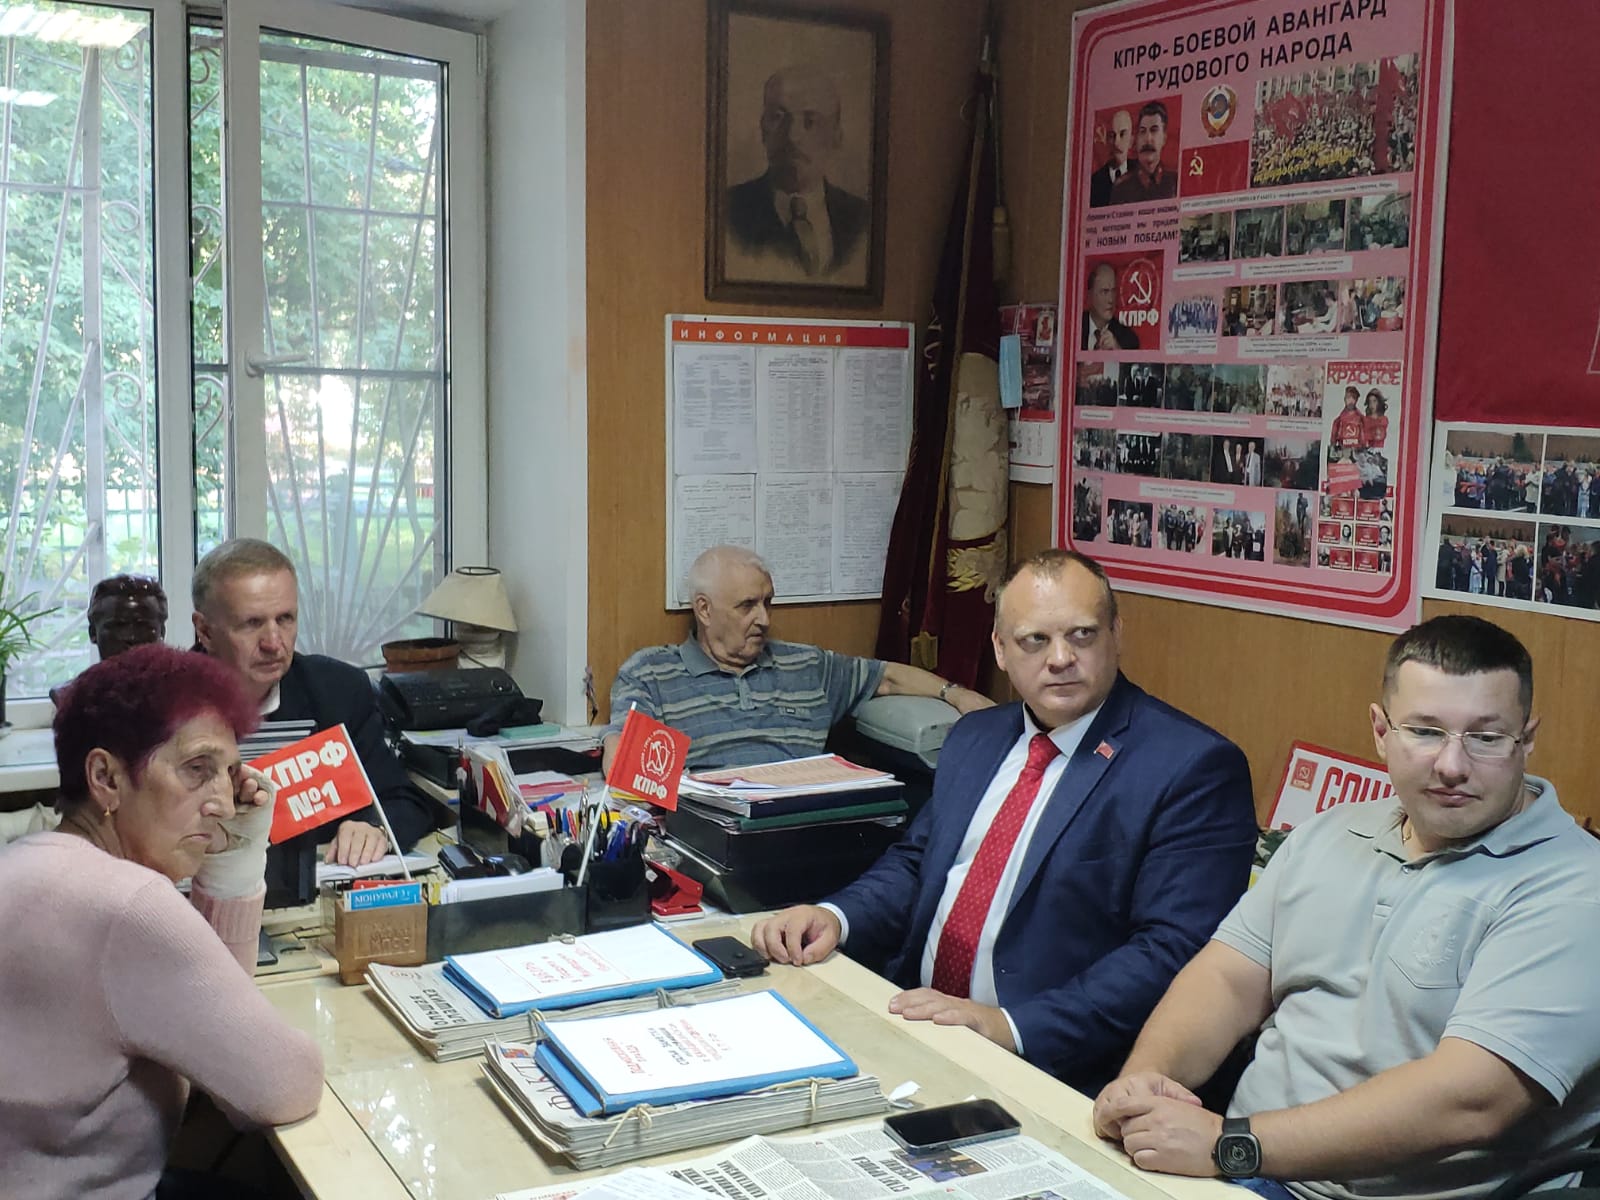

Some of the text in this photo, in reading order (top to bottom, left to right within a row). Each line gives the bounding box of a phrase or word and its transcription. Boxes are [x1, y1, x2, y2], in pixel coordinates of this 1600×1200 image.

[1266, 0, 1387, 37] АВАНГАРД
[1135, 31, 1353, 92] ТРУДОВОГО НАРОДА
[1096, 235, 1127, 247] НОВЫМ
[1118, 308, 1159, 327] КПРФ
[680, 329, 842, 344] ИНФОРМАЦИЯ
[263, 740, 348, 789] КПРФ
[286, 779, 341, 822] №1
[632, 774, 668, 799] КПРФ
